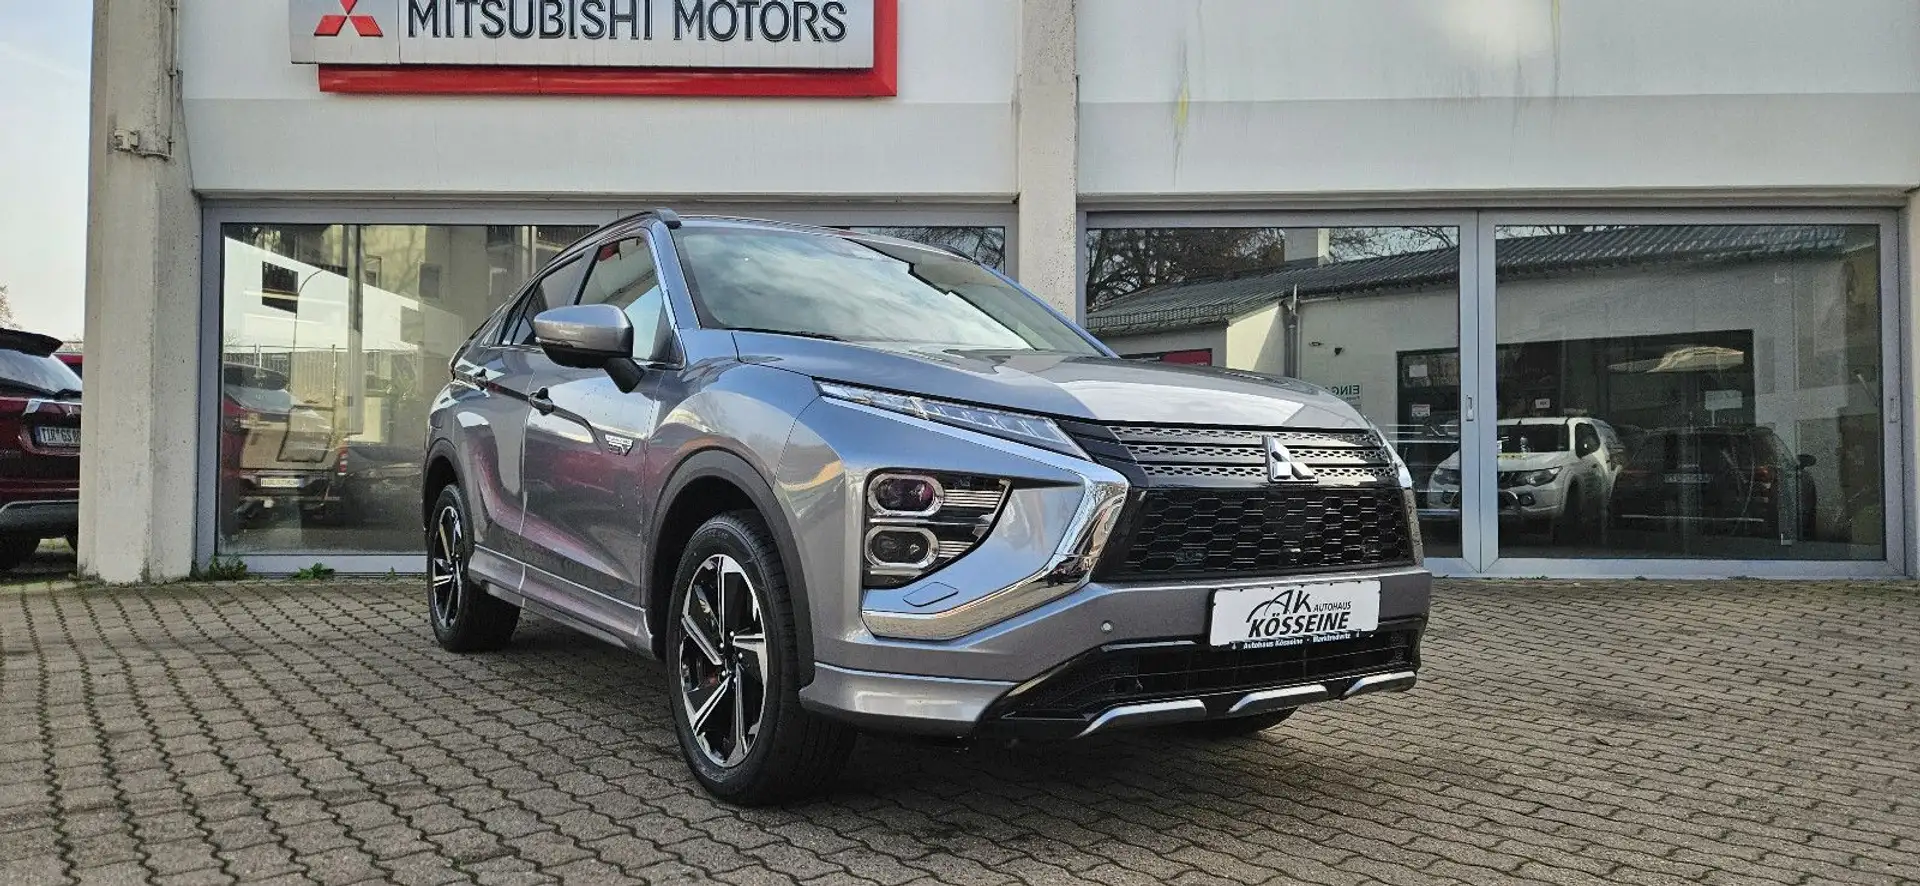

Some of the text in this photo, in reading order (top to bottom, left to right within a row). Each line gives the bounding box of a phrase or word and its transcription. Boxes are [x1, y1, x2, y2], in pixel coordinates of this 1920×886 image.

[408, 0, 847, 42] MITSUBISHI MOTORS
[1313, 601, 1351, 612] AUTOHAUS
[1248, 612, 1351, 637] KÖSSEINE
[1243, 641, 1274, 649] Autohaus
